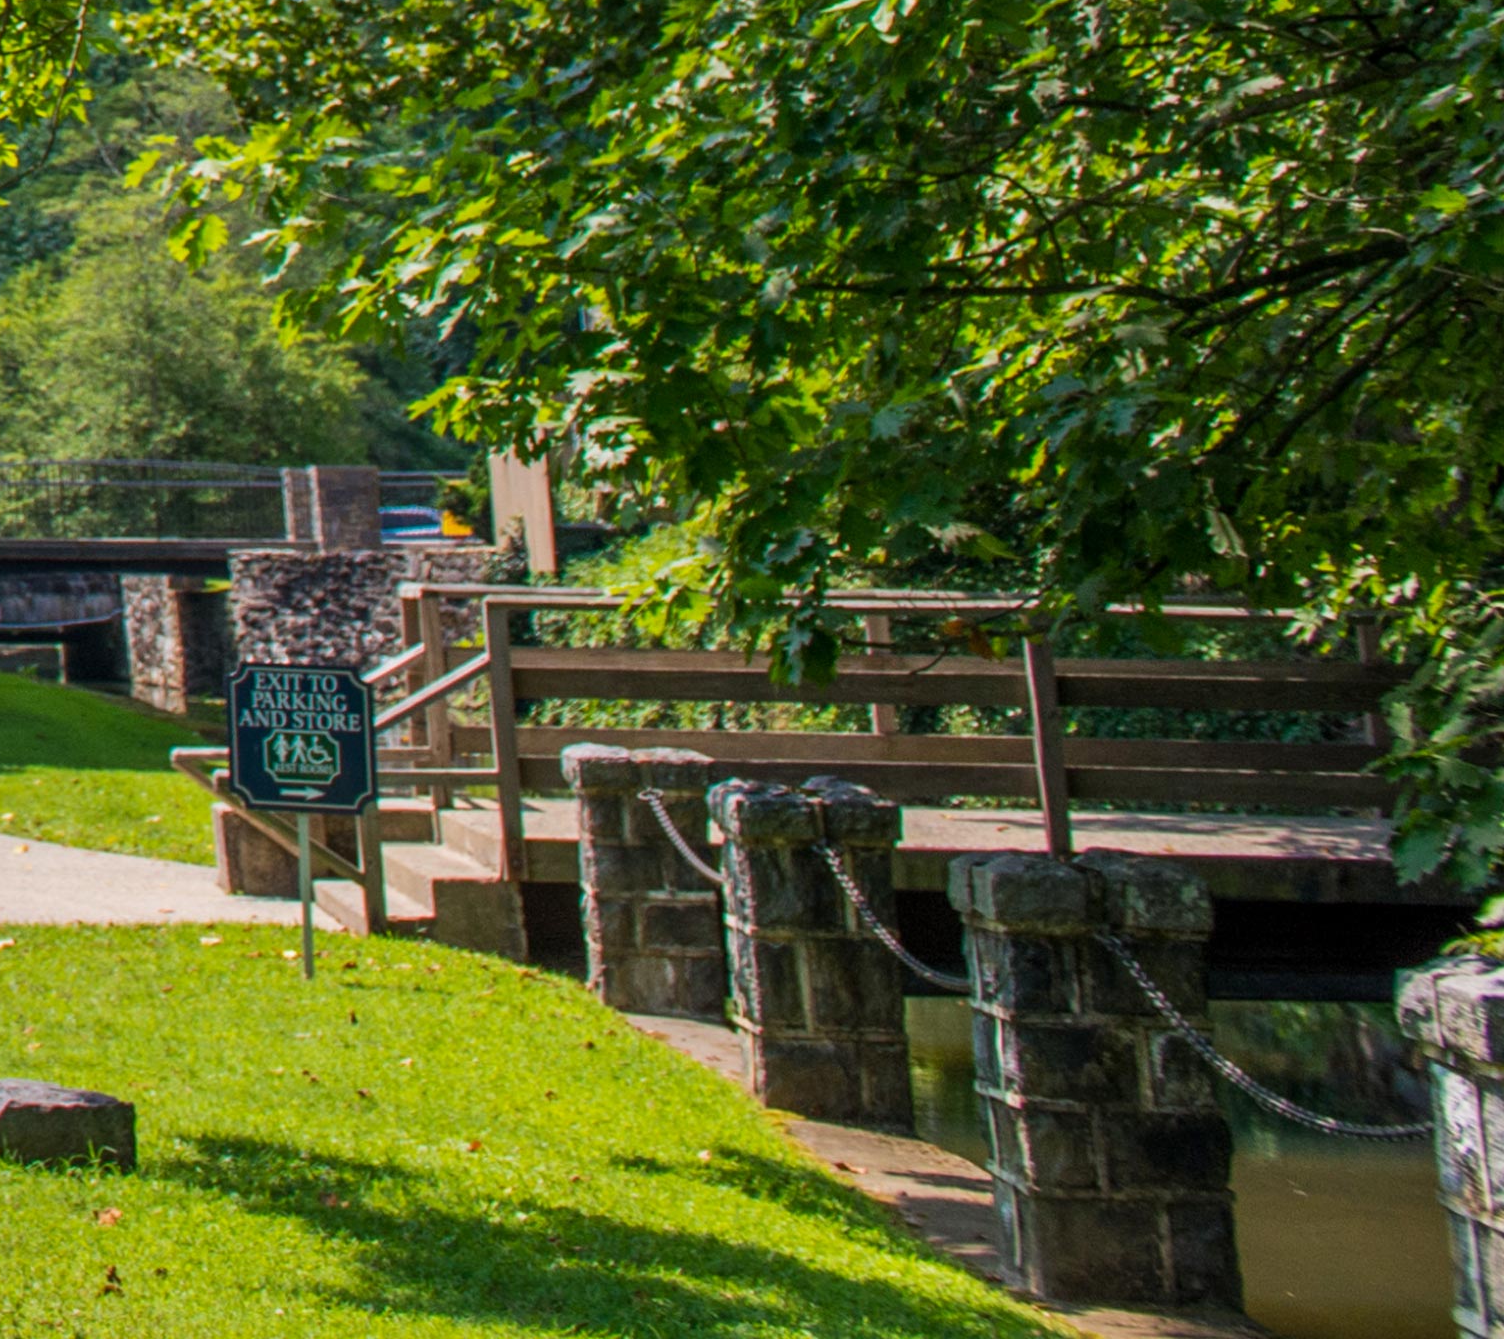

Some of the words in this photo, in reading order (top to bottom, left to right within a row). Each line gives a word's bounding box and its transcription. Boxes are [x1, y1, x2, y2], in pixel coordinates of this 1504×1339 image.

[254, 672, 304, 692] EXIT
[308, 674, 338, 693] TO
[251, 690, 348, 712] PARKING
[239, 708, 287, 728] AND
[291, 710, 362, 732] STORE
